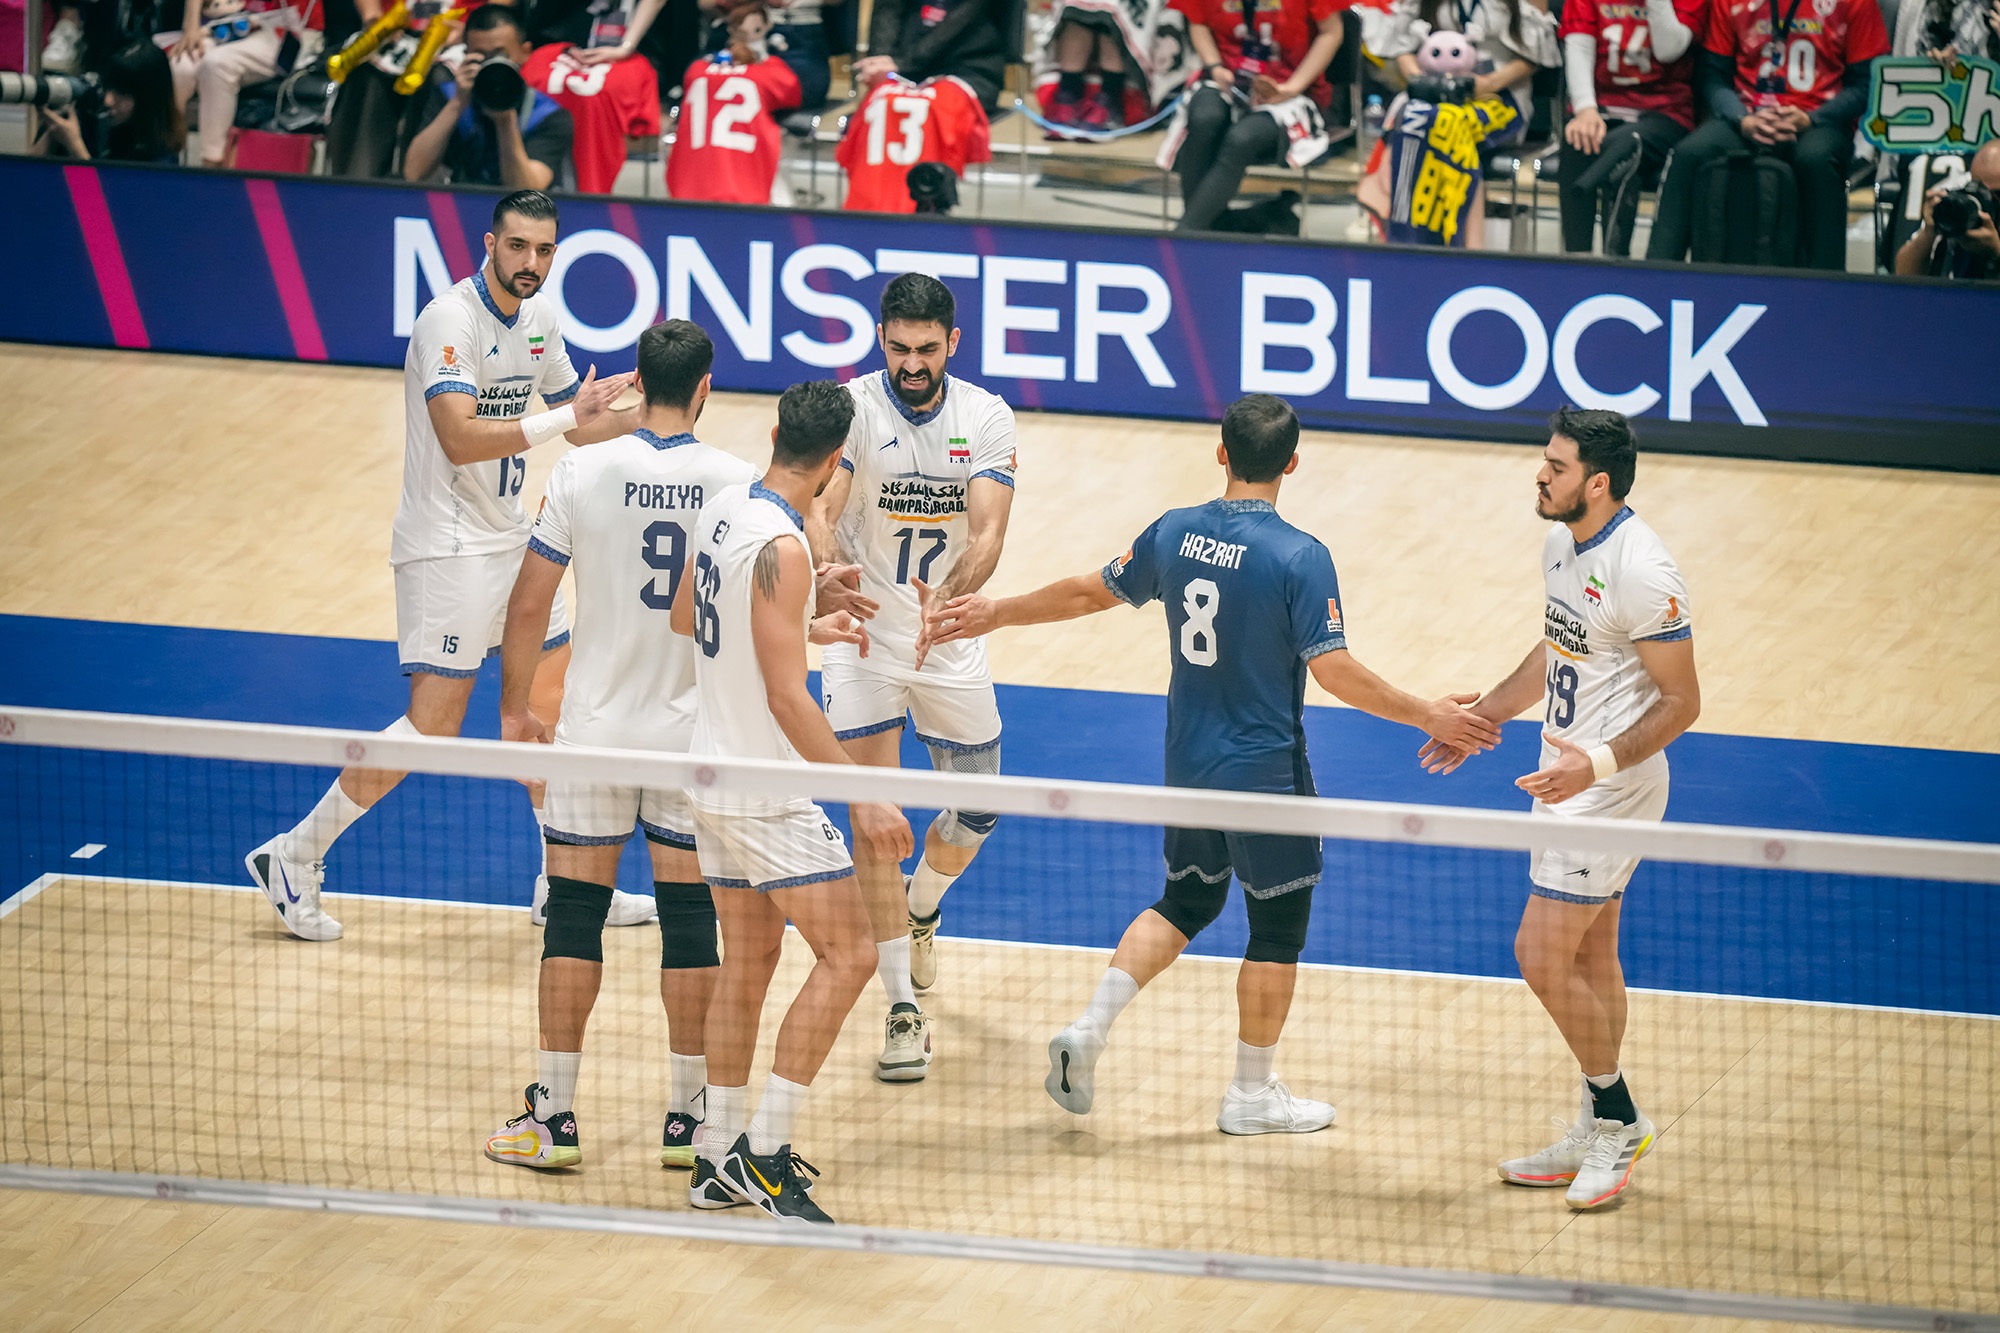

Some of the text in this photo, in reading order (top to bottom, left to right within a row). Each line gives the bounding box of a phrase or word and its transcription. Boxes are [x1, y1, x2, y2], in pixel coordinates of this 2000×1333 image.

[1602, 23, 1652, 74] 14
[687, 77, 761, 152] 12
[864, 96, 930, 166] 13
[1905, 154, 1972, 220] 12
[1240, 271, 1768, 426] BLOCK
[499, 455, 526, 497] 15
[625, 482, 704, 510] PORIYA
[640, 520, 687, 610] 9
[893, 527, 948, 585] 17
[1179, 532, 1247, 570] HAZRAT
[442, 634, 459, 654] 15
[1180, 578, 1220, 667] 8
